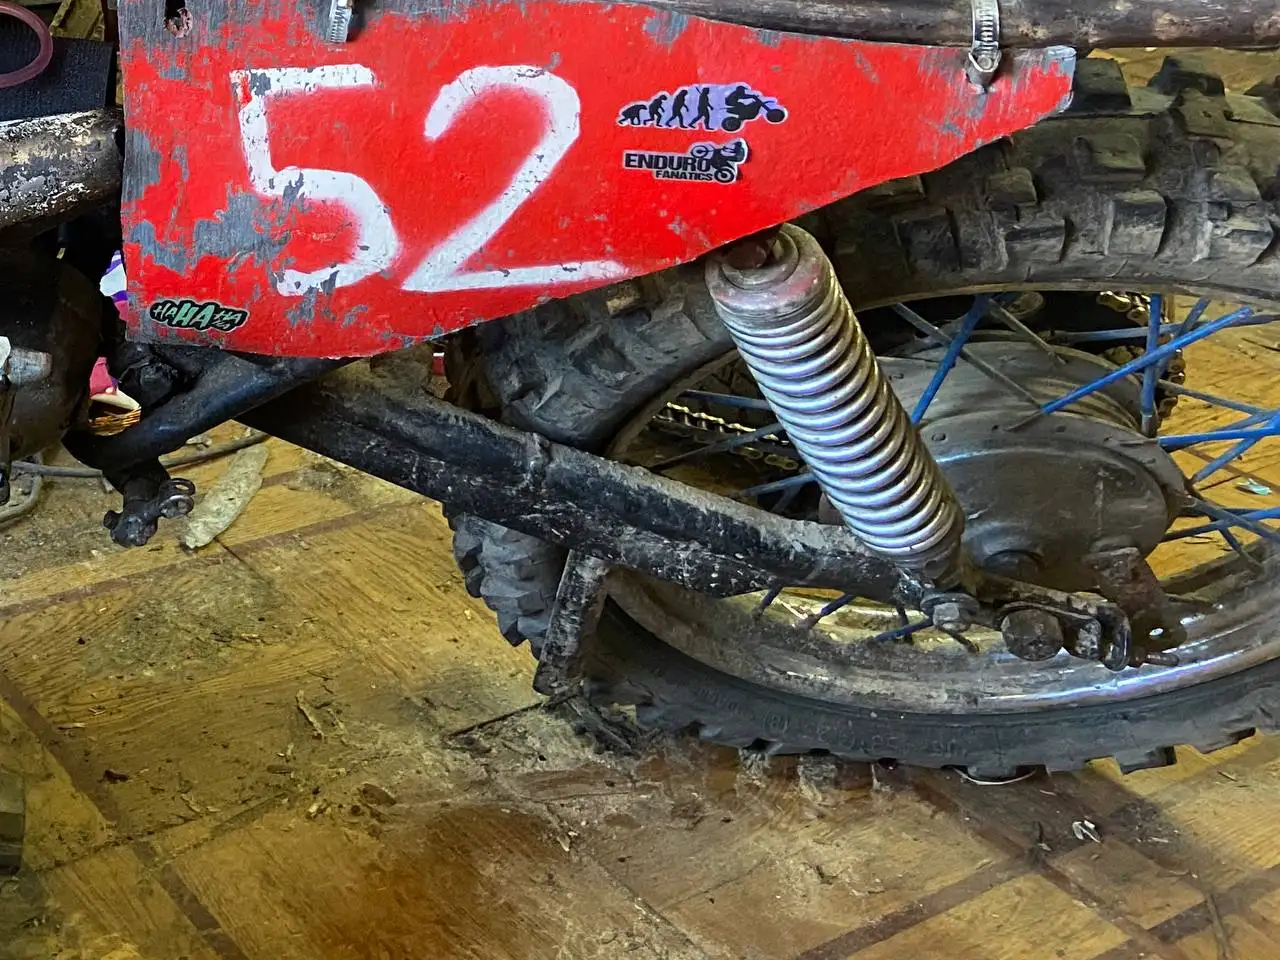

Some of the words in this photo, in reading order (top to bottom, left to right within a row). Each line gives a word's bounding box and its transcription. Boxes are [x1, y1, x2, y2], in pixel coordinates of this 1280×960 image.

[624, 152, 713, 173] ENDURO
[229, 62, 626, 297] 52
[655, 169, 714, 182] FANATICS
